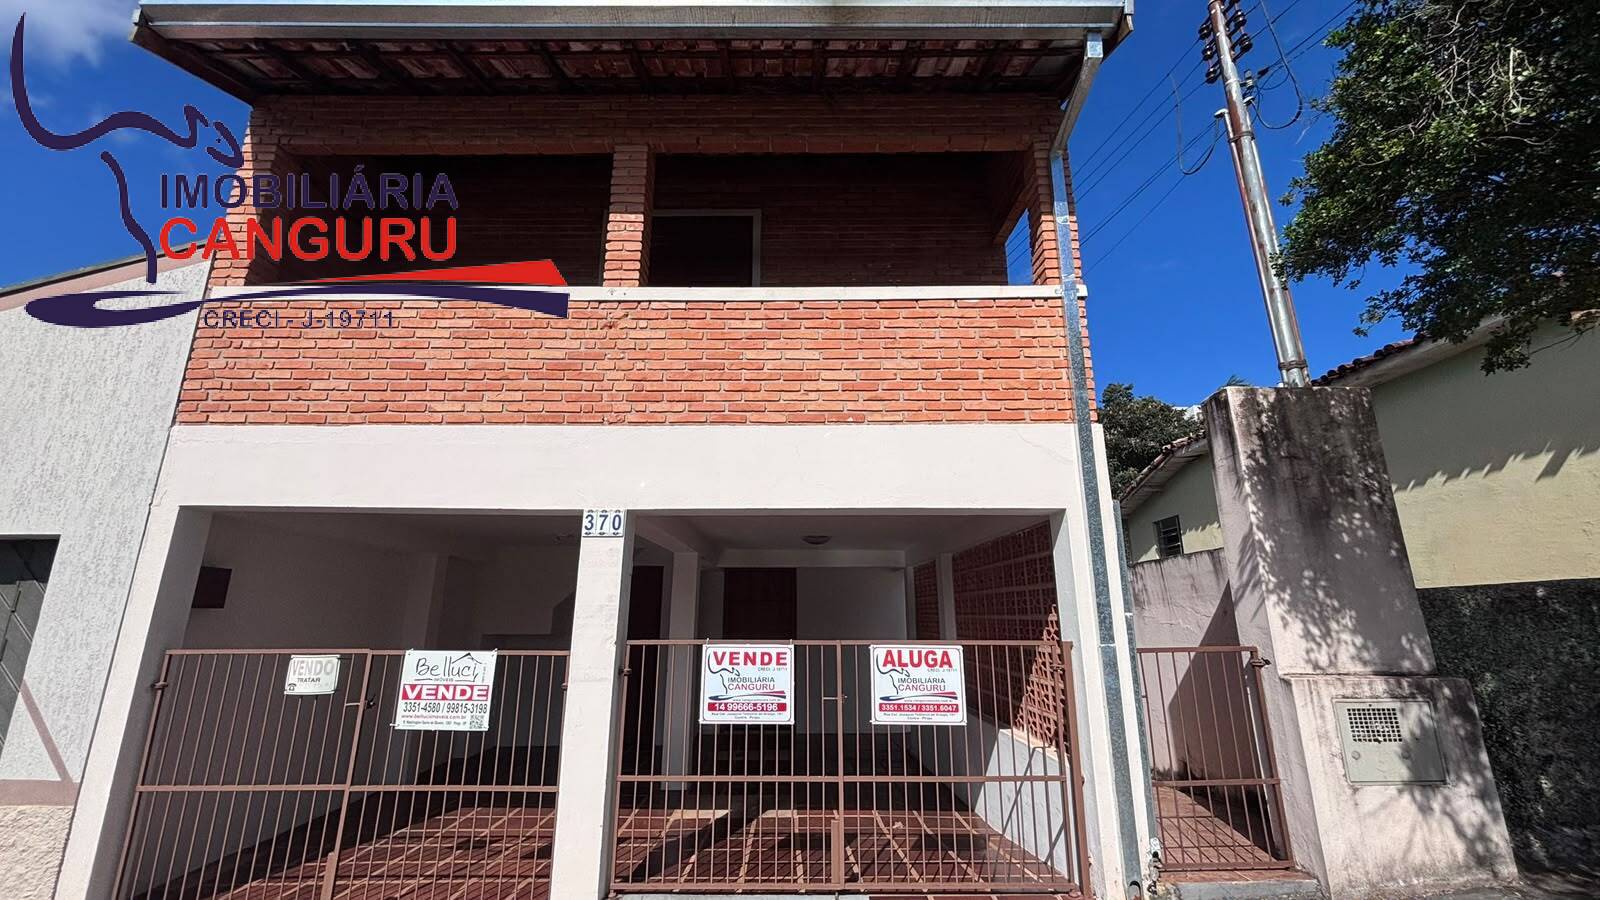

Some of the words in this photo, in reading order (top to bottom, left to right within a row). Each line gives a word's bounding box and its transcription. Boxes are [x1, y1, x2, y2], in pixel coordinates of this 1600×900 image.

[584, 514, 622, 531] 370
[713, 651, 788, 666] VENDE
[882, 649, 953, 668] ALUGA
[291, 659, 335, 676] VENDO
[415, 656, 476, 678] Belluci
[404, 685, 489, 700] VENDE
[403, 702, 440, 713] 3351-4580
[446, 703, 488, 714] 99815-3198
[714, 703, 726, 711] 14
[727, 703, 778, 711] 99666-5196
